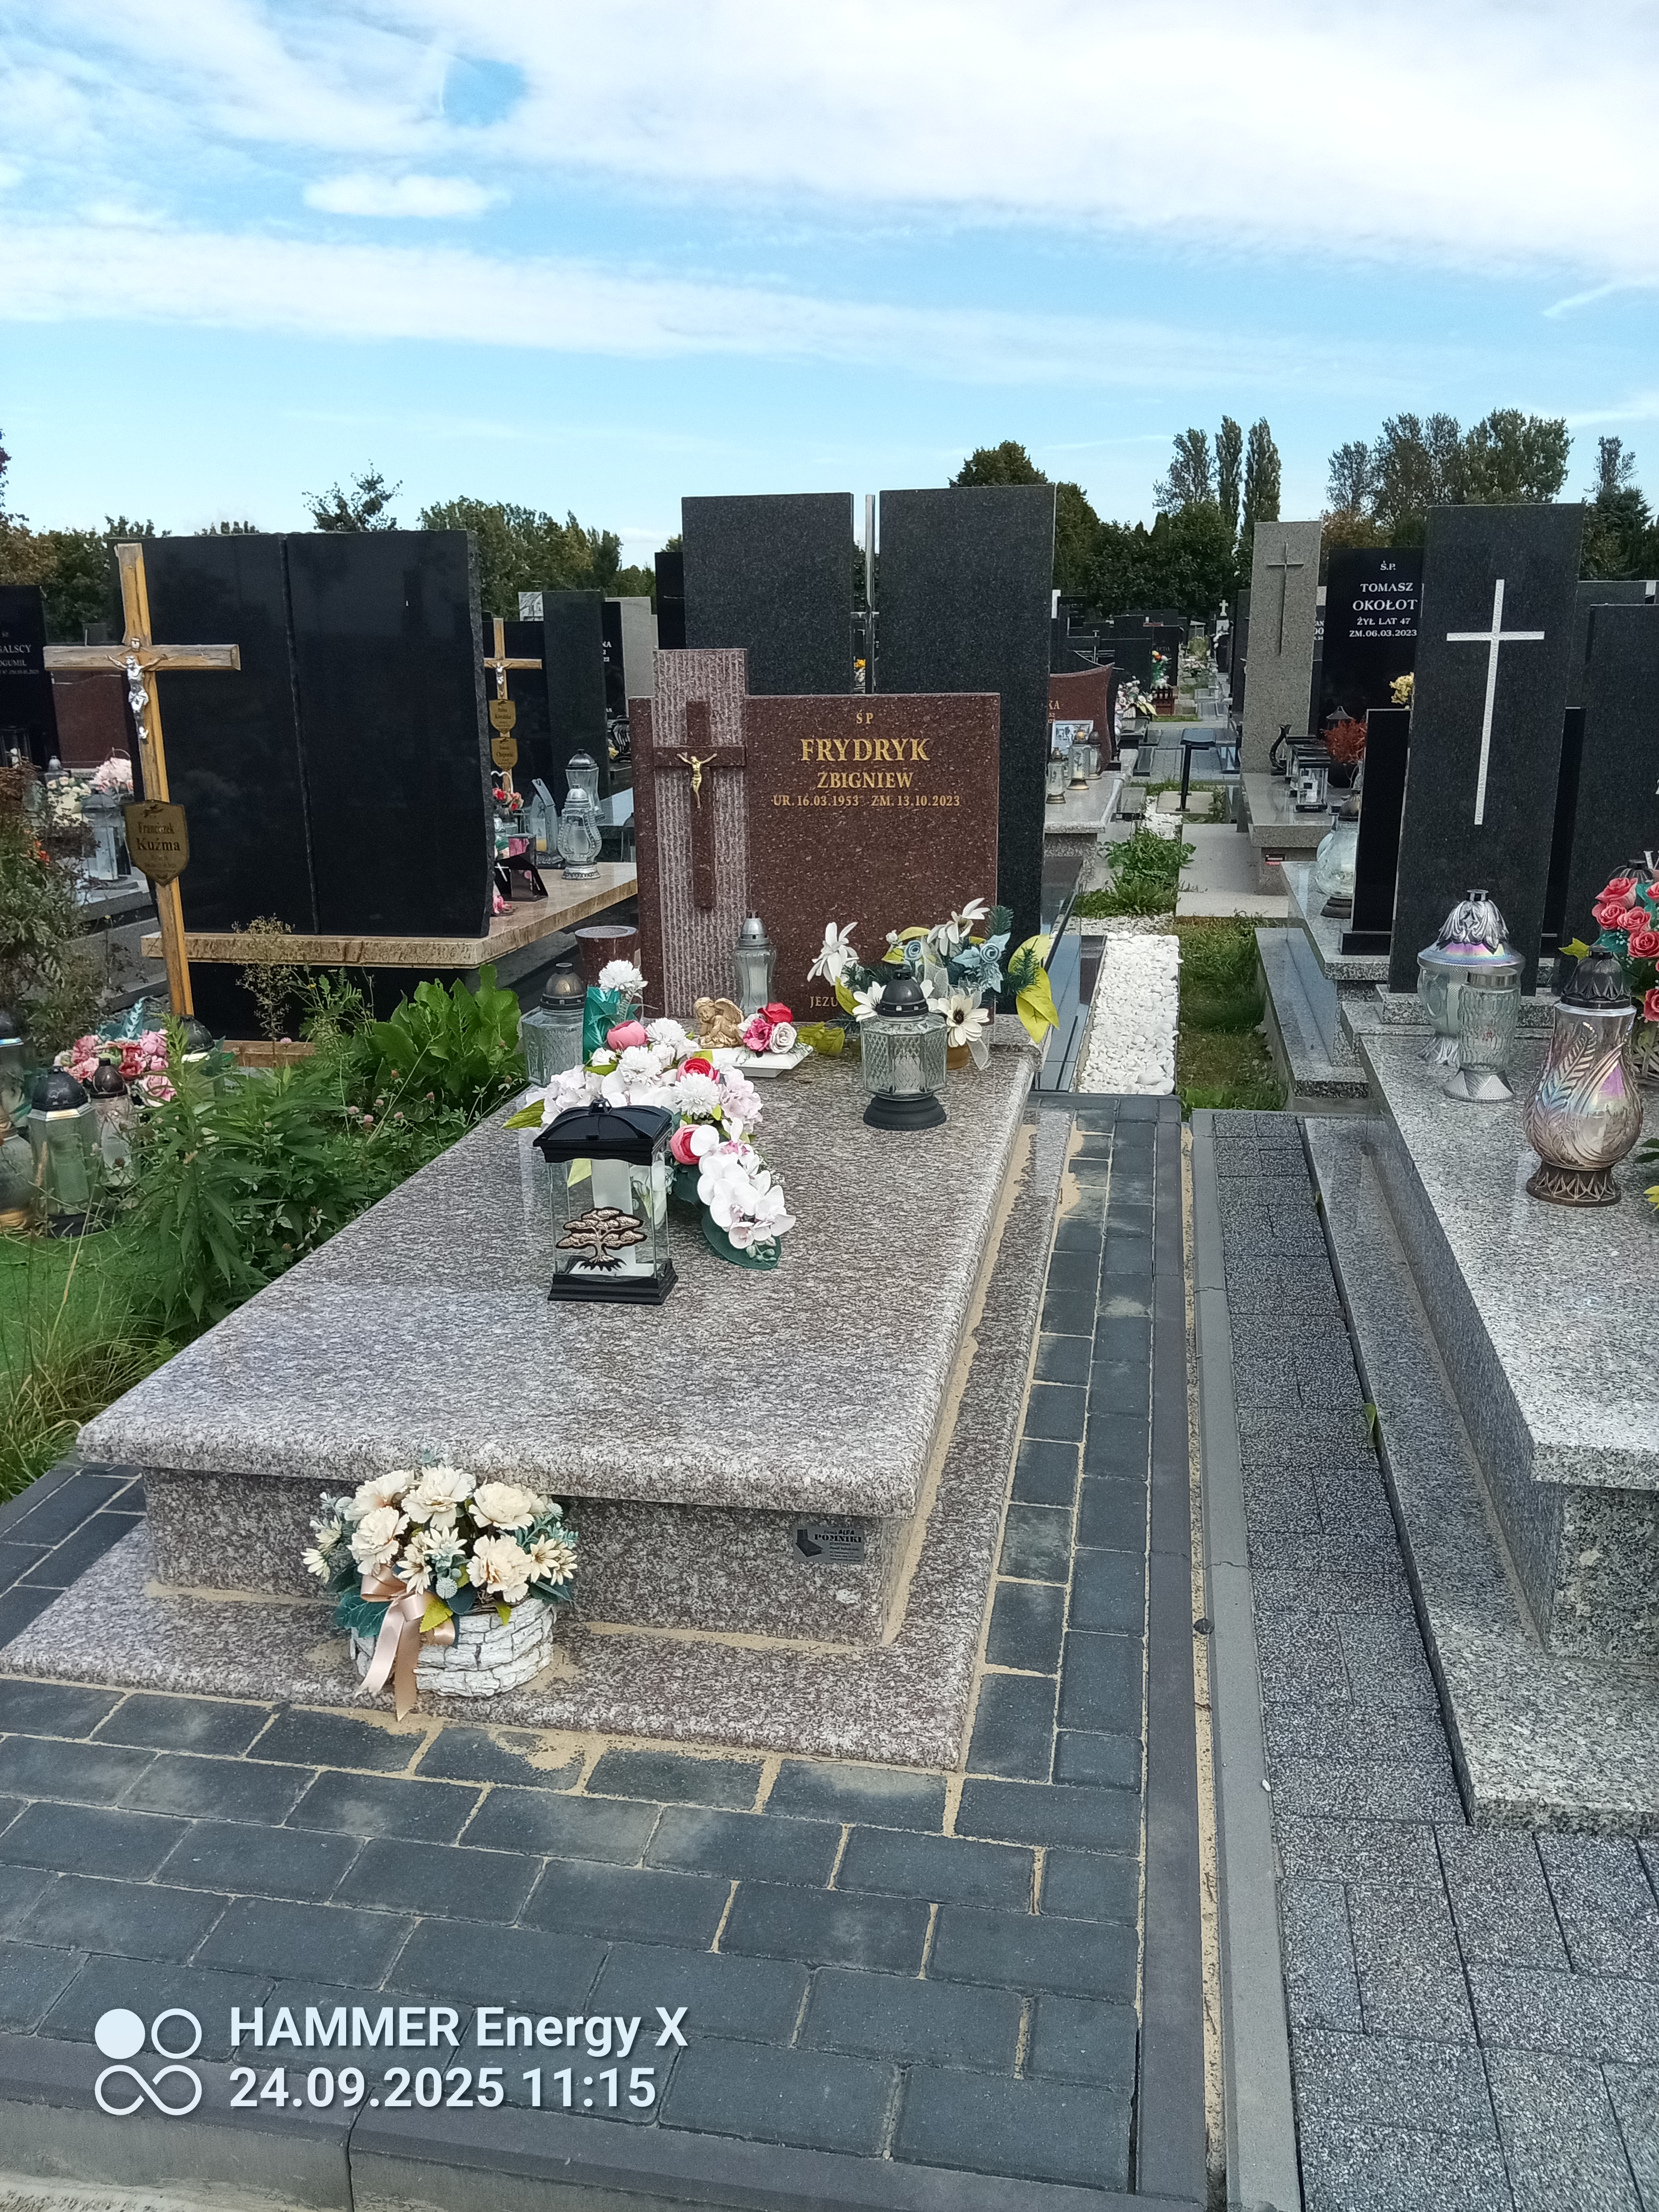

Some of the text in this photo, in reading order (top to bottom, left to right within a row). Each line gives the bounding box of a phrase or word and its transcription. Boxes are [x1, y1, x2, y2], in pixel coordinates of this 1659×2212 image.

[1360, 582, 1413, 592] TOMASZ
[1352, 599, 1418, 611] OKOŁOT
[1356, 616, 1376, 625] ŻYŁ
[1349, 629, 1418, 638] ZM.06.03.2023
[800, 738, 931, 761] FRYDRYK
[816, 772, 914, 789] ZBIGNIEW
[773, 794, 960, 807] UR. 16.03.1953 ZM. 13.10.2023
[814, 1534, 862, 1543] POMNIKI
